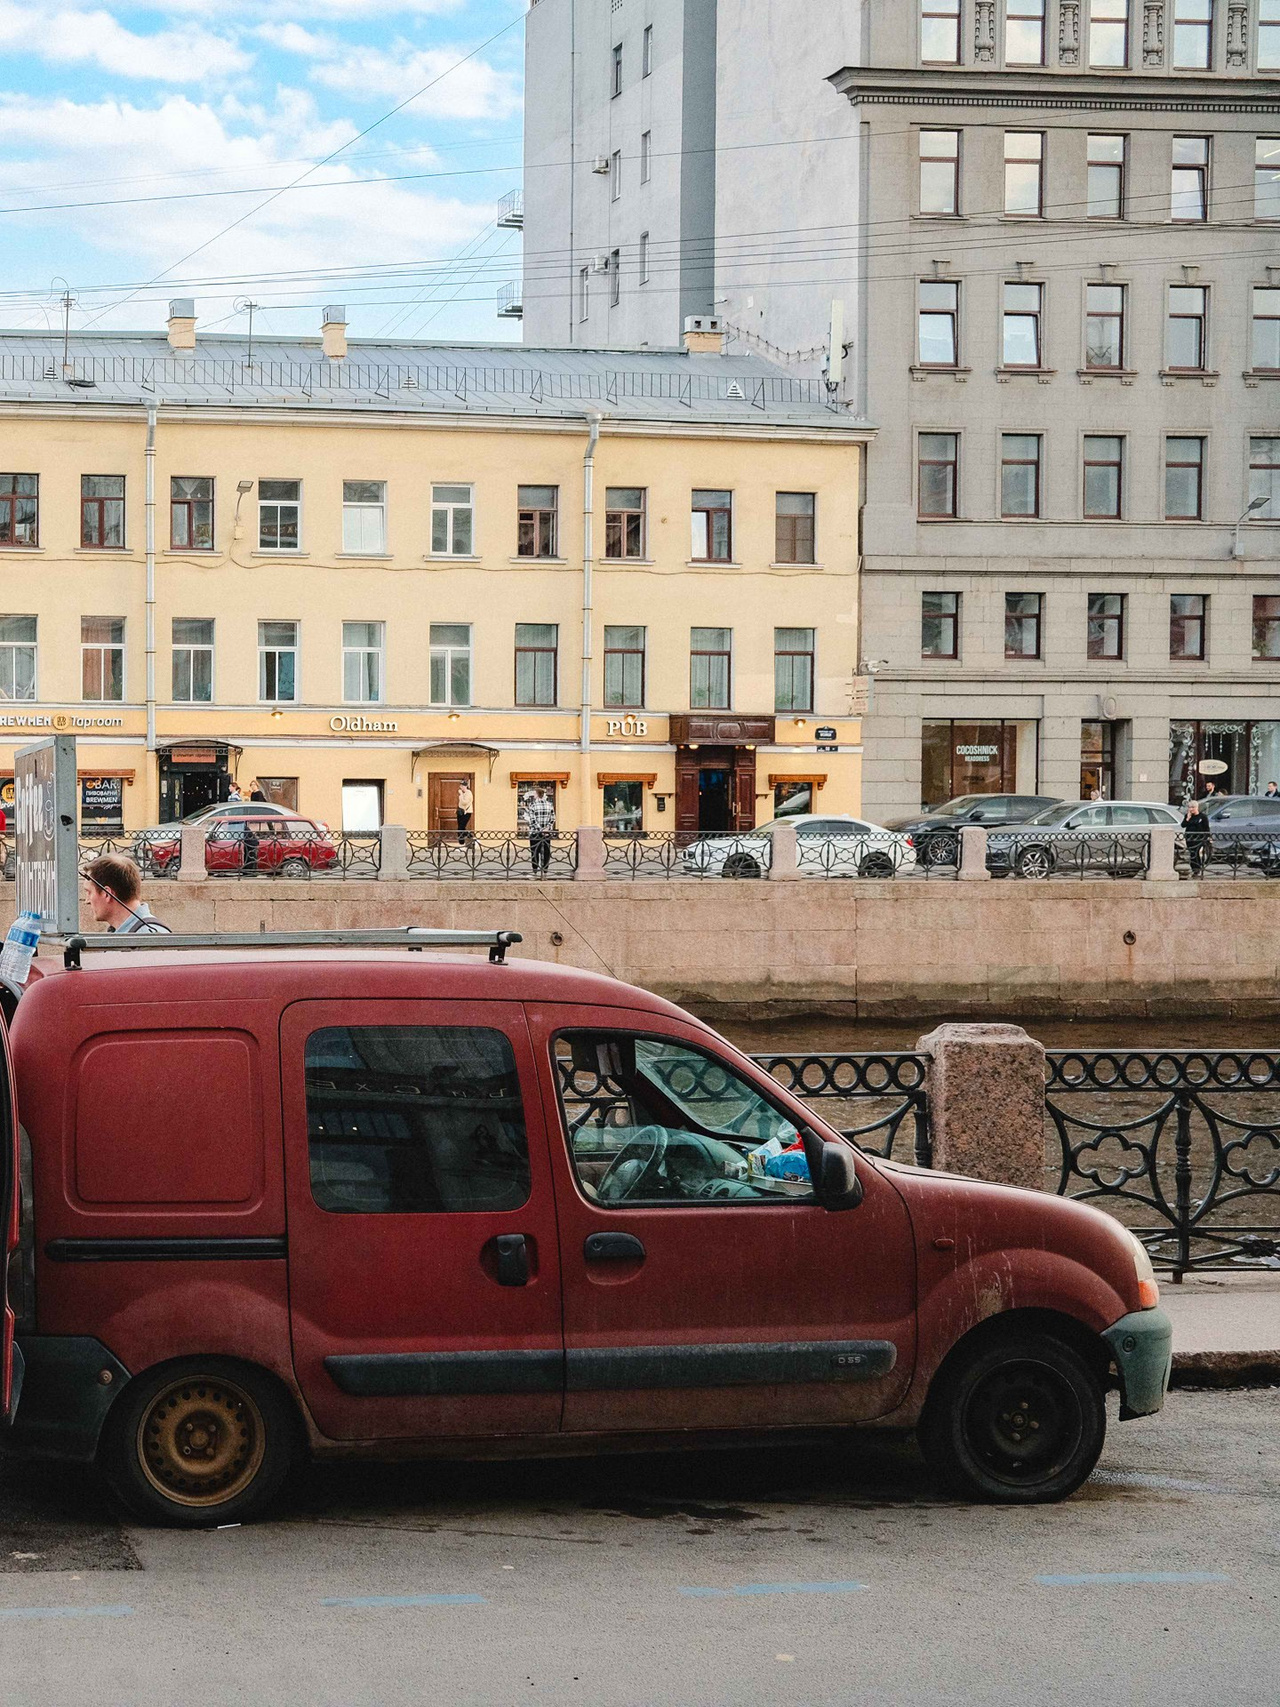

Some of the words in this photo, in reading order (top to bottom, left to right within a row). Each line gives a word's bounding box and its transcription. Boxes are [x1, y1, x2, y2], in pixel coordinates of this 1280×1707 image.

[70, 716, 123, 729] Taproom
[330, 716, 398, 731] Oldham
[607, 720, 648, 736] PUB
[956, 745, 998, 755] COCOSHNICK
